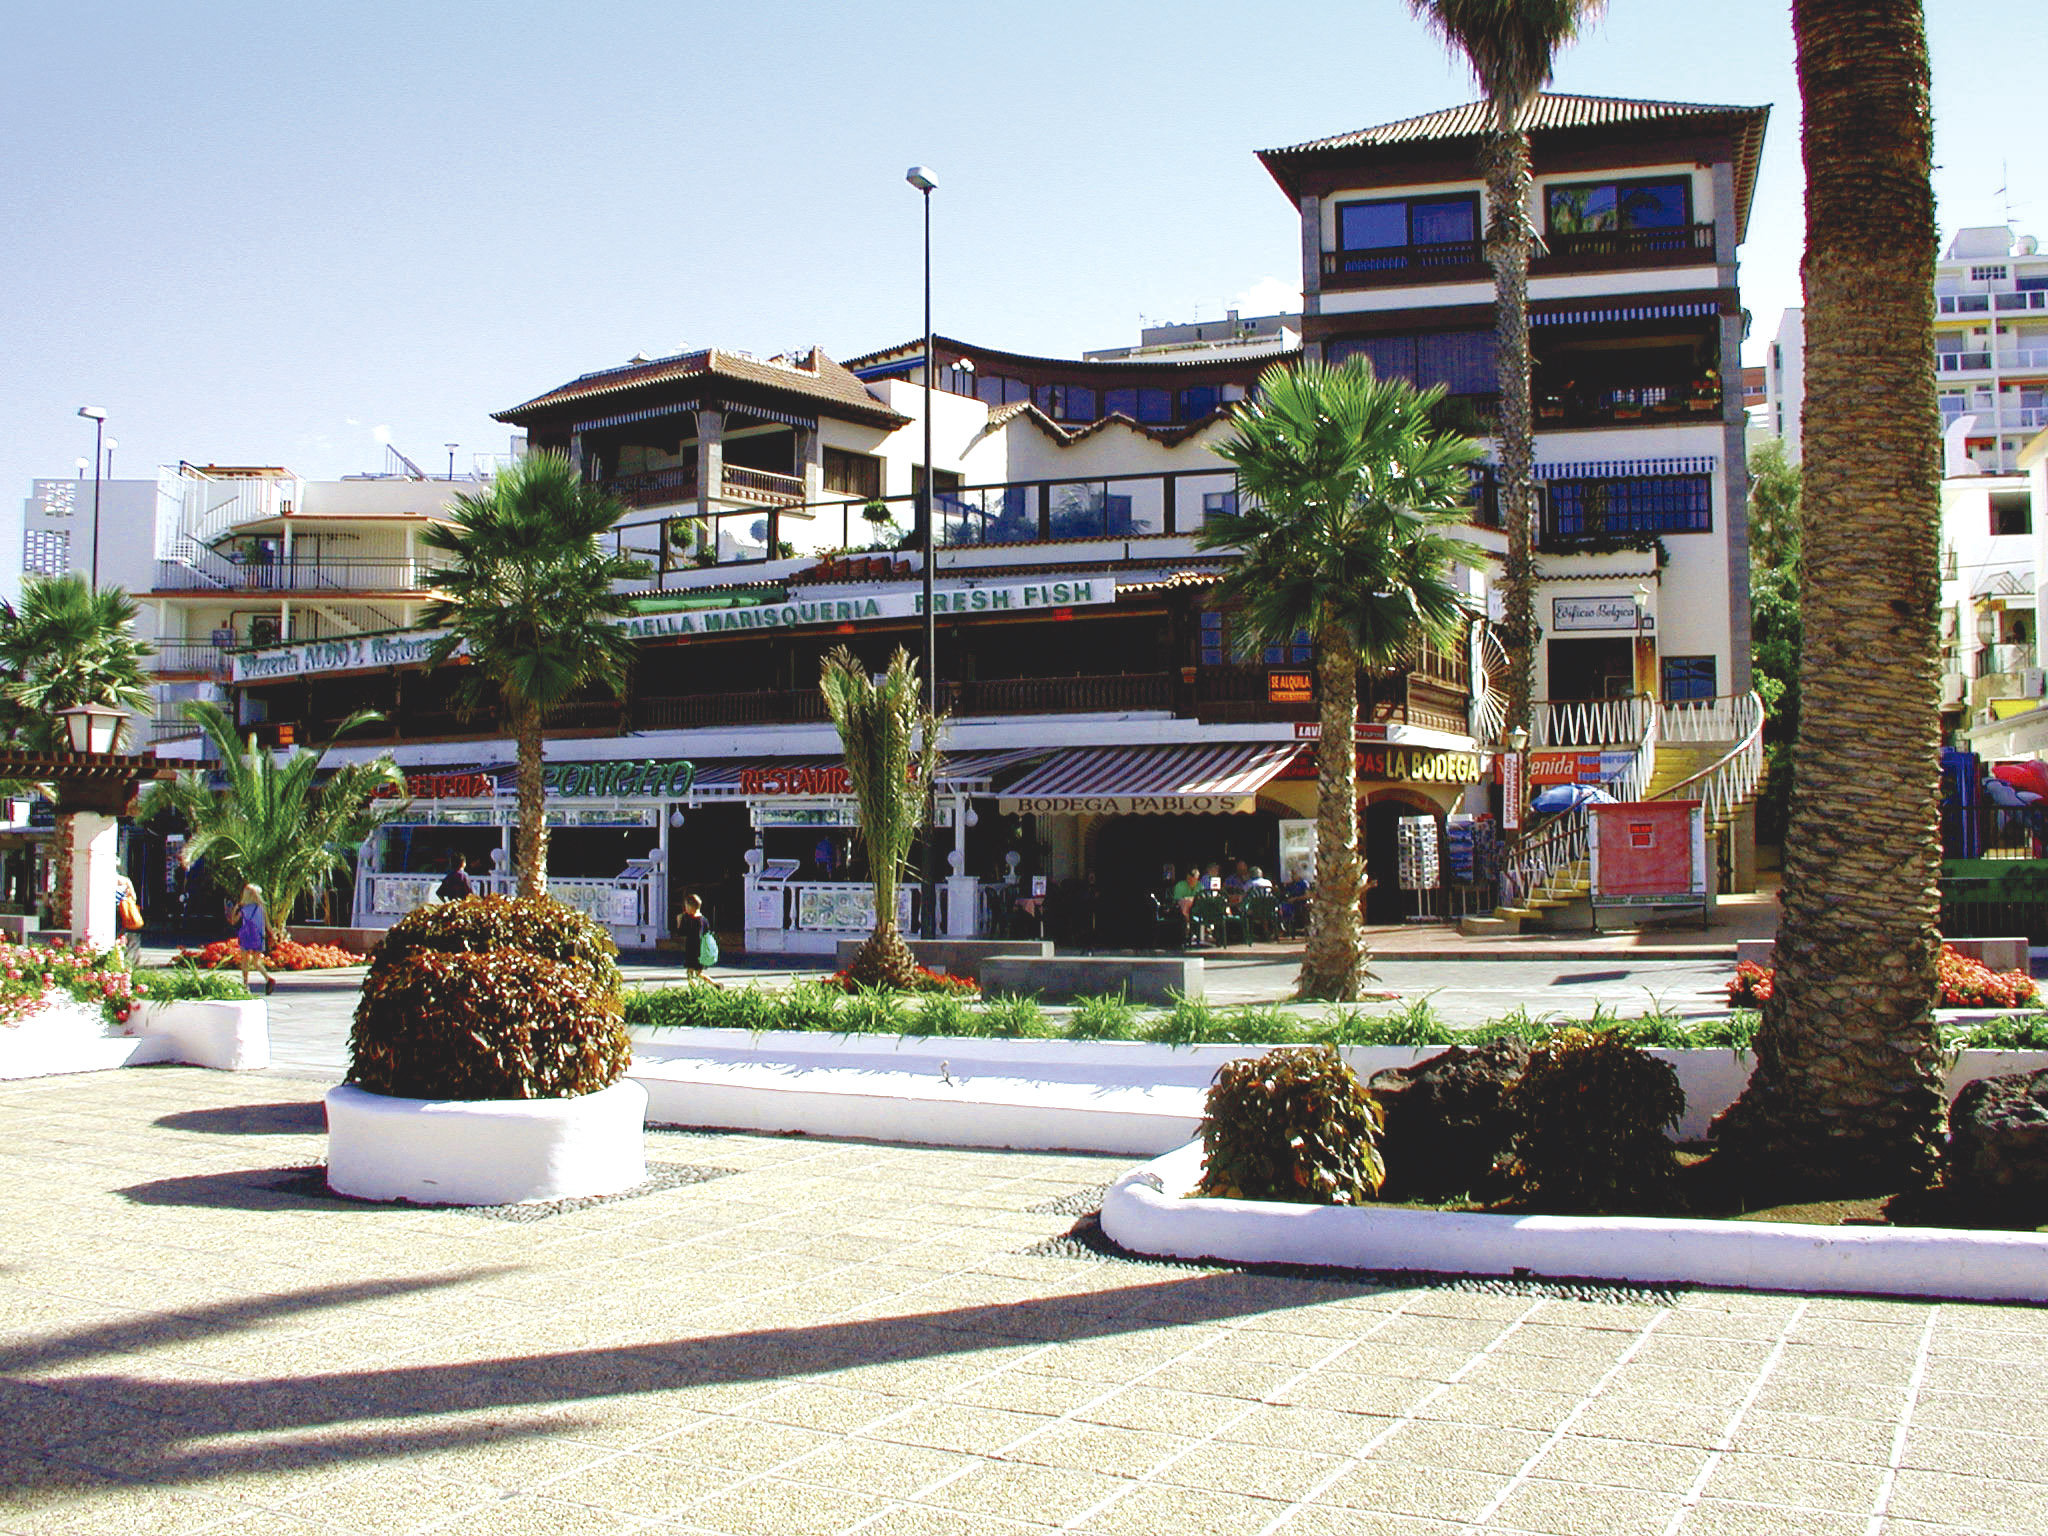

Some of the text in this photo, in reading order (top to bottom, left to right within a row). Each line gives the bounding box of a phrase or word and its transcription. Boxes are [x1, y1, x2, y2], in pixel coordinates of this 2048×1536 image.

[703, 598, 881, 632] MARISQUERIA
[914, 589, 1009, 614] FRESH
[1023, 581, 1092, 606] FISH
[238, 650, 298, 678] Pizzeria
[303, 640, 347, 671] ALDO
[1355, 752, 1385, 773] PAS
[1385, 750, 1481, 783] LA BODEGA
[1017, 795, 1236, 813] BODEGA PABLO'S
